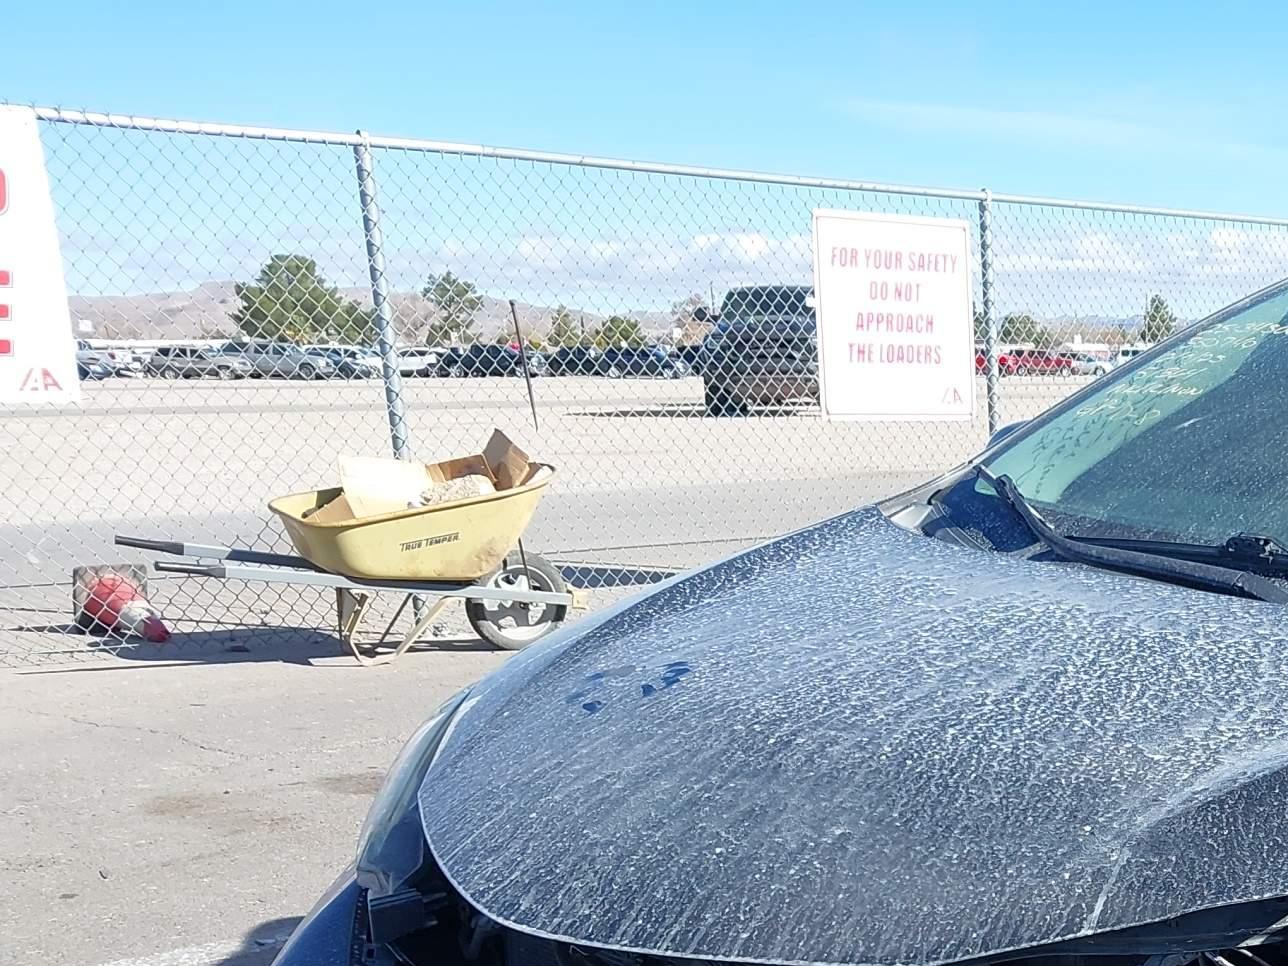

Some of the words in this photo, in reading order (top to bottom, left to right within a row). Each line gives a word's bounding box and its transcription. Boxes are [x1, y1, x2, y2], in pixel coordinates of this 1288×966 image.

[832, 247, 858, 267] FOR
[864, 249, 902, 270] YOUR
[909, 252, 957, 274] SAFETY
[870, 281, 888, 300] DO
[894, 283, 921, 302] NOT
[856, 312, 934, 334] APPROACH
[848, 343, 874, 363] THE
[880, 344, 941, 365] LOADERS
[399, 539, 423, 552] TRUE
[424, 532, 459, 547] TEMPER
